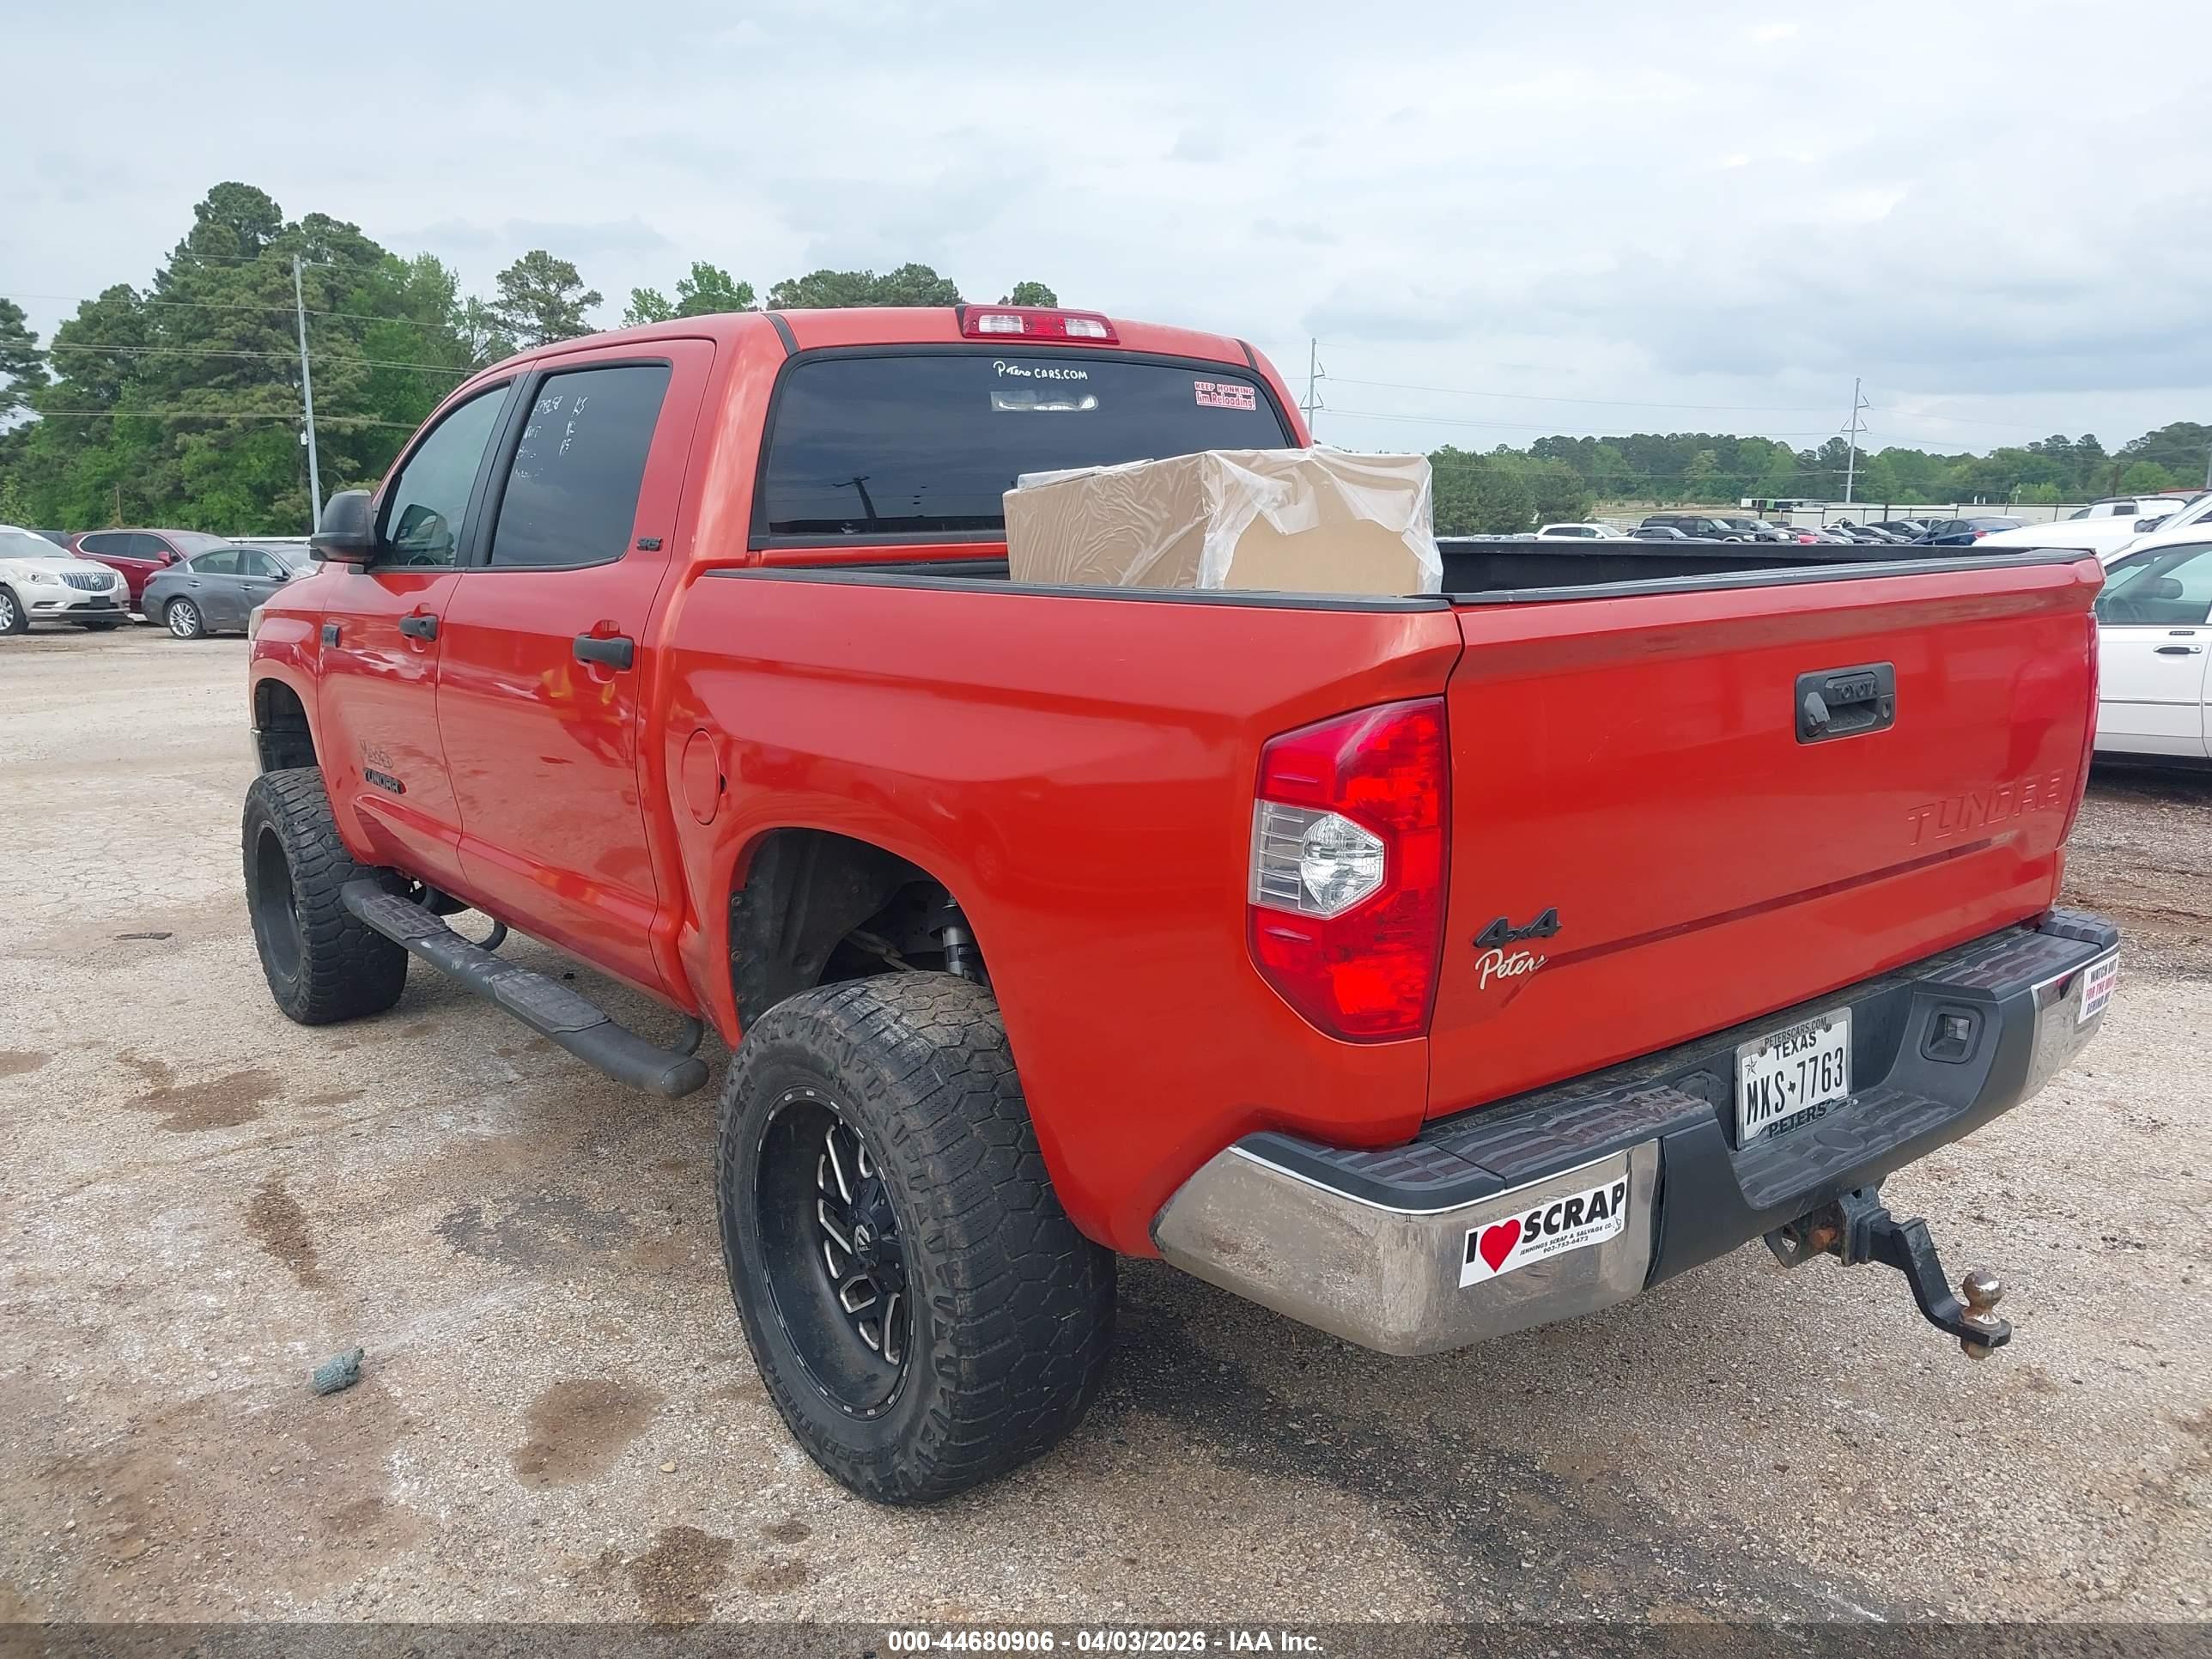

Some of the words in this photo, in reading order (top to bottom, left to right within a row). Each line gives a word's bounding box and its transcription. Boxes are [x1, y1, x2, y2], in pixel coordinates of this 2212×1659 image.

[1034, 368, 1089, 380] CARS.COM
[1194, 382, 1215, 391] KEEP
[1218, 384, 1255, 395] HONKING
[1212, 393, 1256, 410] Reloading!
[1906, 769, 2064, 846] TUNDRA
[1473, 907, 1563, 949] 4x4
[1773, 1030, 1817, 1060] TEXAS
[1747, 1070, 1786, 1126] MKS
[1796, 1046, 1844, 1105] 7763
[1465, 1231, 1479, 1265] I
[1522, 1182, 1626, 1244] SCRAP
[1519, 1241, 1549, 1256] JENNINGS
[1548, 1235, 1568, 1247] SCRAP
[1575, 1224, 1604, 1238] SALVAGE
